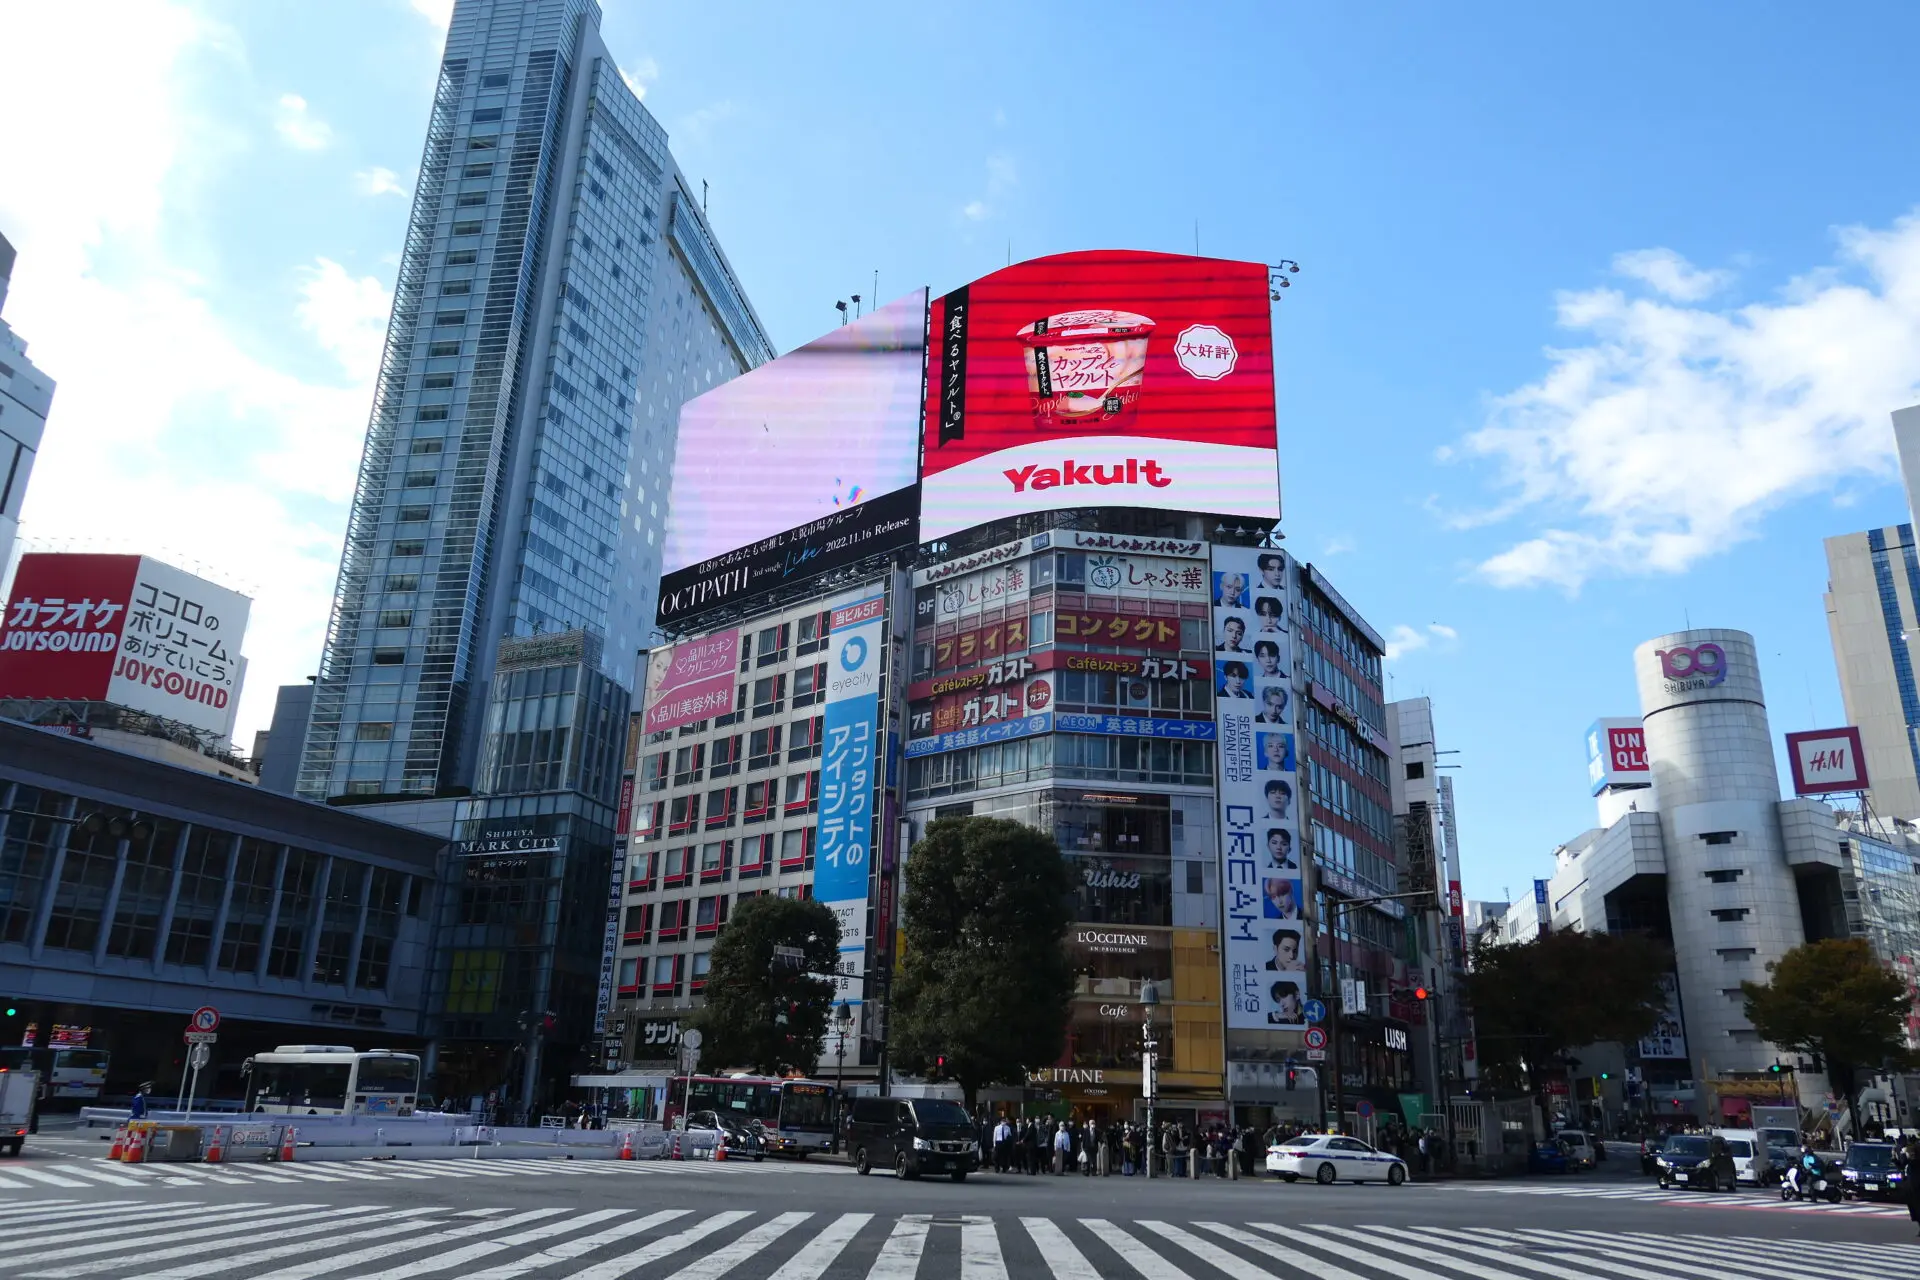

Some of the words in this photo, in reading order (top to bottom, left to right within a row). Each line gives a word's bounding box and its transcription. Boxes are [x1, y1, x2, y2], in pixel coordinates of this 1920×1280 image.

[1182, 341, 1231, 362] 大好評
[1053, 370, 1115, 388] ヤクルト
[1003, 458, 1172, 493] Yakult
[1075, 532, 1202, 556] しゃぶしゃぶバイキング
[660, 566, 748, 616] OCTPATH
[752, 567, 764, 578] 3rd
[764, 562, 783, 576] single
[826, 529, 872, 553] 2022.11.16
[875, 515, 910, 536] Release
[926, 541, 1023, 582] しゃぶしゃぶバイキング
[967, 568, 1024, 602] しゃぶ葉
[1128, 563, 1203, 590] しゃぶ葉
[8, 597, 123, 629] カラオケ
[135, 582, 220, 631] ココロの
[835, 602, 878, 626] 当ビル5F
[918, 599, 934, 615] 9F
[1, 630, 117, 652] JOYSOUND
[130, 610, 235, 665] ボリューム、
[1056, 614, 1176, 643] コンタクト
[687, 638, 734, 662] 品川スキン
[937, 622, 1026, 664] プライス
[124, 635, 232, 686] あげていこう。
[686, 657, 728, 677] クリニック
[987, 658, 1034, 686] ガスト
[1141, 658, 1198, 681] ガスト
[1655, 642, 1727, 688] 109
[114, 655, 229, 709] JOYSOUND
[831, 671, 873, 692] eyecity
[1664, 679, 1706, 693] SHIBUYA
[657, 689, 729, 724] 品川美容外科
[962, 692, 1018, 727] ガスト
[1029, 692, 1049, 703] ガスト
[909, 740, 935, 753] AEON
[943, 722, 1025, 750] 英会話イーオン
[1030, 717, 1044, 729] 6F
[911, 712, 932, 731] 7F
[1060, 715, 1097, 730] AEON
[1106, 717, 1213, 737] 英会話イーオン
[1225, 714, 1237, 751] JAPAN
[1239, 715, 1252, 783] SEVENTEEN
[1613, 732, 1646, 748] UN
[1810, 749, 1845, 772] H&M
[1226, 766, 1239, 783] EP
[822, 727, 850, 868] アイシティ
[846, 721, 869, 866] コンタクトの
[459, 840, 513, 853] MARK
[518, 837, 563, 850] CITY
[485, 829, 534, 839] SHIBUYA
[1083, 868, 1141, 889] Ushi8
[1226, 805, 1258, 941] DREAM
[1077, 931, 1148, 946] L'OCCITANE
[1232, 963, 1243, 1012] RELEASE
[1243, 963, 1260, 1013] 11/9
[1100, 1004, 1128, 1019] Café
[1384, 1027, 1407, 1051] LUSH
